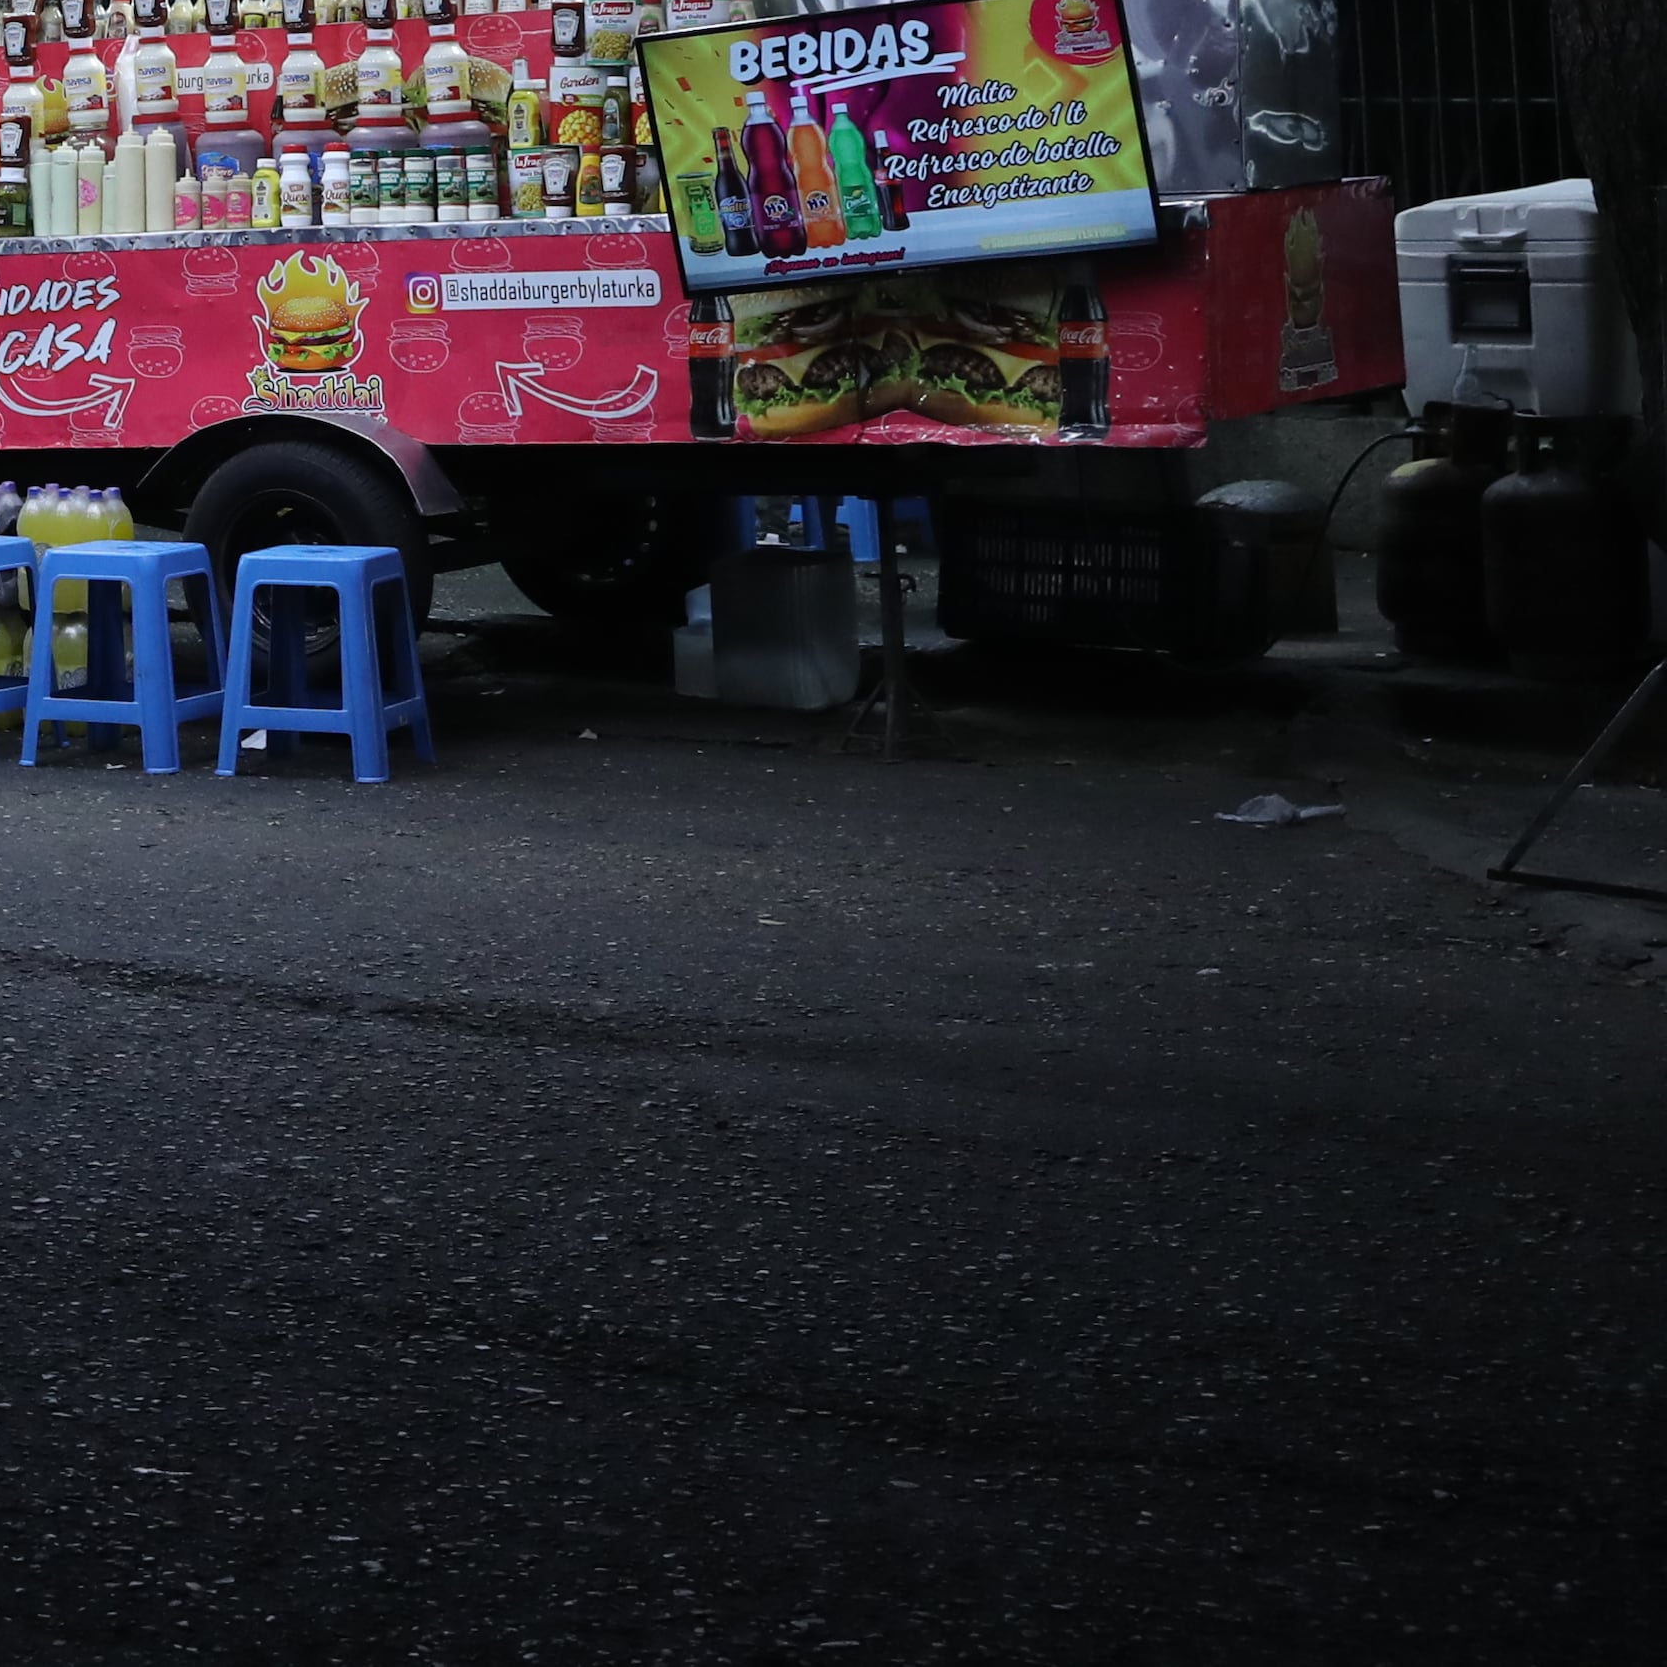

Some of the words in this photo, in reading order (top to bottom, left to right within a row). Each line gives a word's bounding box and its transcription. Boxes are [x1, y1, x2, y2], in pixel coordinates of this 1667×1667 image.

[727, 20, 933, 83] BEBIDAS
[559, 75, 600, 89] Garden
[936, 80, 1018, 109] Malta
[906, 114, 1014, 145] Refresco
[1015, 104, 1048, 132] de
[1049, 101, 1064, 127] 1
[1065, 100, 1087, 126] lt
[883, 147, 998, 182] Refresco
[999, 140, 1032, 167] de
[1033, 130, 1122, 165] botella
[926, 170, 1094, 209] Energetizante
[445, 275, 657, 307] @shaddaiburgerbylaturka
[241, 374, 387, 414] Shaddai
